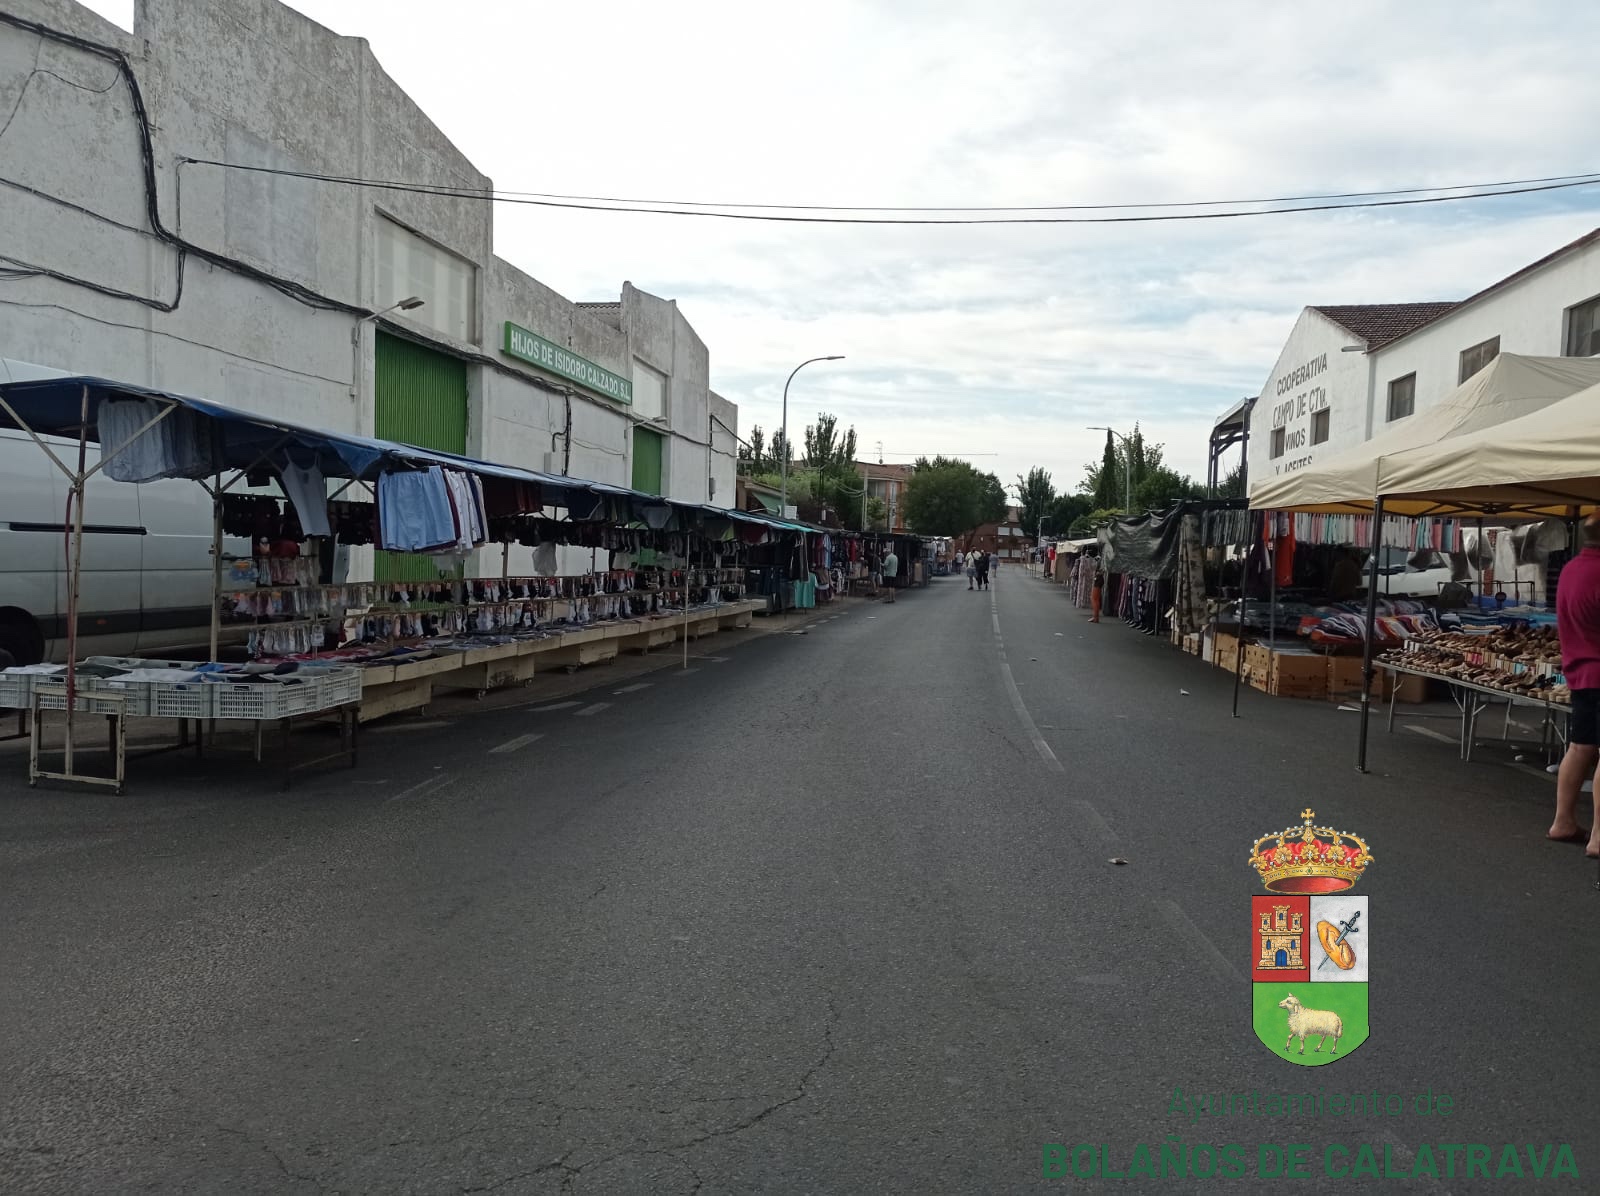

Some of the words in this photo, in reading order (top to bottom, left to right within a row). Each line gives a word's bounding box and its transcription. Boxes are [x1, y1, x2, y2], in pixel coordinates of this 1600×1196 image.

[511, 330, 539, 359] HIJOS
[541, 344, 553, 365] DE
[554, 350, 586, 380] ISIDORO
[1277, 352, 1327, 396] COOPERATIVA
[1273, 399, 1294, 428] CAMPO
[1296, 392, 1307, 418] DE
[1285, 428, 1306, 451] VINOS
